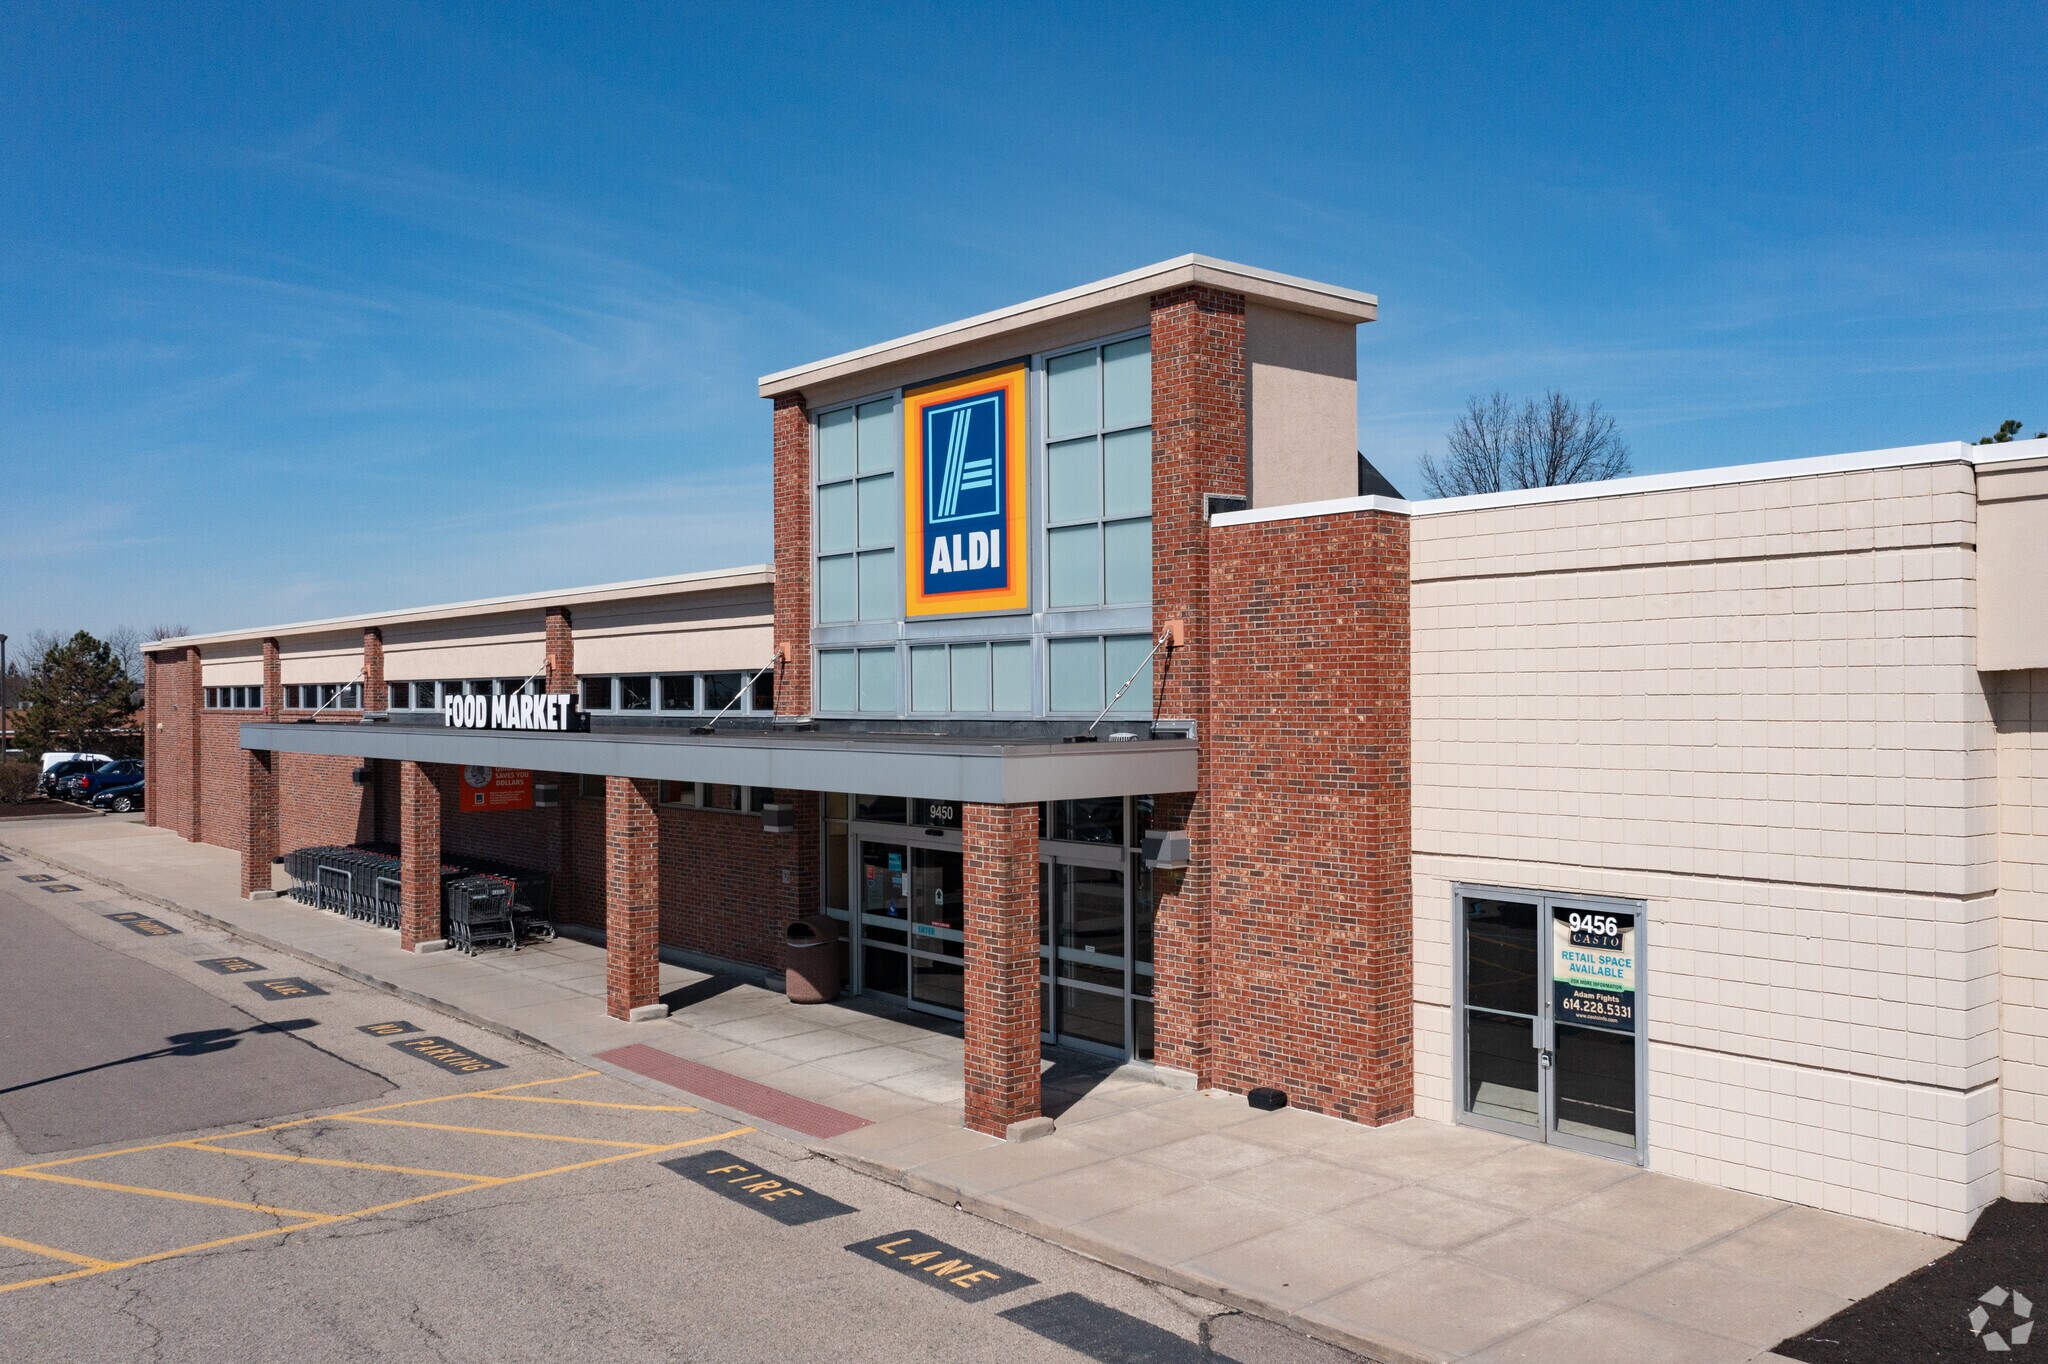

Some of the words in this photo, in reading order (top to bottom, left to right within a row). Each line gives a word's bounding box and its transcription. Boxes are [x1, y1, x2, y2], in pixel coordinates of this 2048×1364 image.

[930, 529, 1000, 574] ALDI
[445, 694, 487, 728] FOOD
[491, 694, 570, 730] MARKET
[930, 805, 953, 819] 9450
[1568, 912, 1618, 937] 9456
[1573, 934, 1619, 947] CASTO
[1561, 950, 1596, 963] RETAIL
[1598, 955, 1632, 968] SPACE
[1569, 963, 1624, 978] AVAILABLE
[1573, 990, 1595, 999] Adam
[1592, 981, 1623, 990] INFORMATION
[1563, 998, 1632, 1018] 614.228.5331
[367, 1023, 404, 1035] NO
[405, 1039, 491, 1071] PARKING
[706, 1164, 804, 1202] FIRE
[875, 1238, 1001, 1288] LANE
